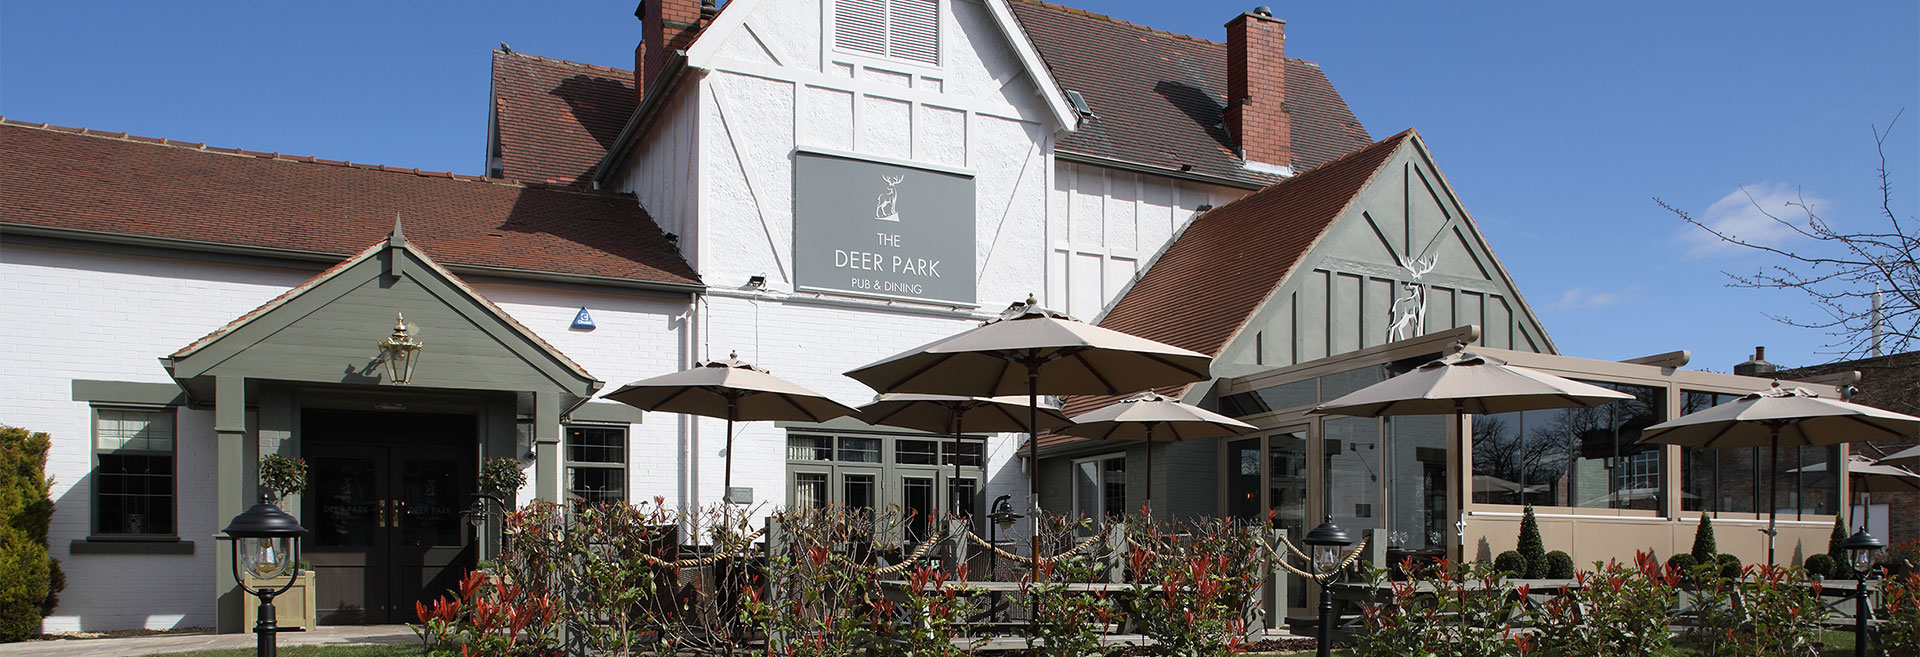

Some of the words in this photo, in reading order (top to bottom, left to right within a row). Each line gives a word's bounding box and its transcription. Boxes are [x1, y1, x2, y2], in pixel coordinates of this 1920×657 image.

[877, 232, 901, 247] THE
[834, 249, 884, 272] DEER
[892, 255, 941, 278] PARK
[851, 277, 871, 290] PUB
[873, 280, 881, 291] &
[884, 281, 923, 295] DINING
[323, 505, 346, 513] DEER
[348, 505, 369, 513] PARK
[409, 506, 429, 514] DEER
[432, 506, 452, 514] PARK
